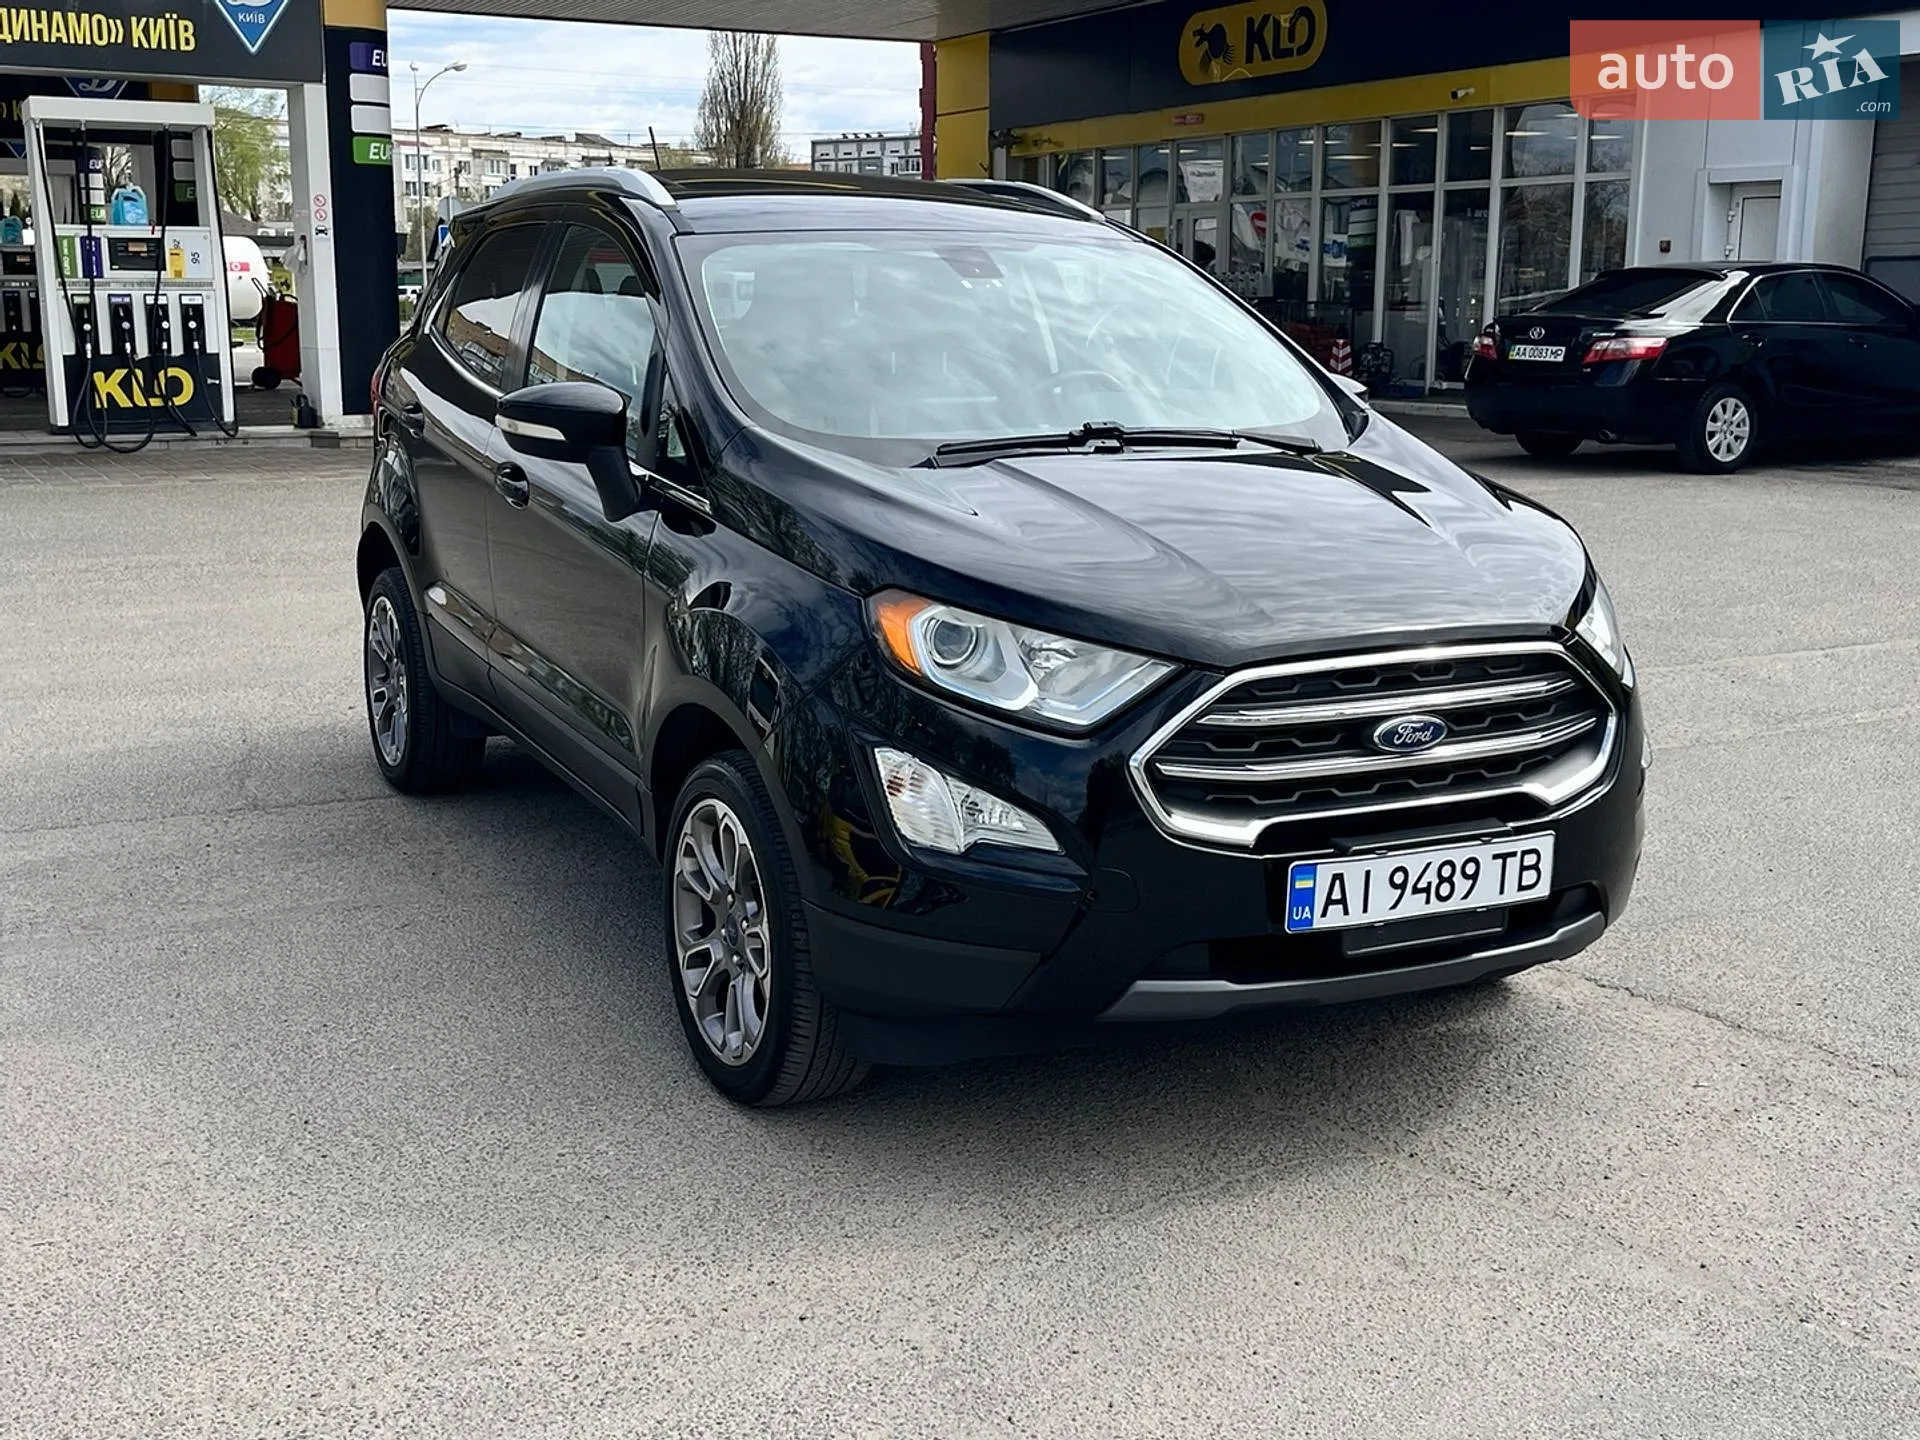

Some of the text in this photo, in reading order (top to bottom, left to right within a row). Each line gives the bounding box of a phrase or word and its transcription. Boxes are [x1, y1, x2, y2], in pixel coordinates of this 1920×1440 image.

[131, 13, 196, 51] КИЇВ
[238, 12, 266, 24] КИЇВ
[1245, 6, 1316, 64] KLO
[190, 251, 201, 264] 95
[93, 367, 194, 409] KLO
[1393, 722, 1434, 745] Ford
[1320, 848, 1542, 918] AI 9489 TB
[1293, 906, 1312, 921] UA
